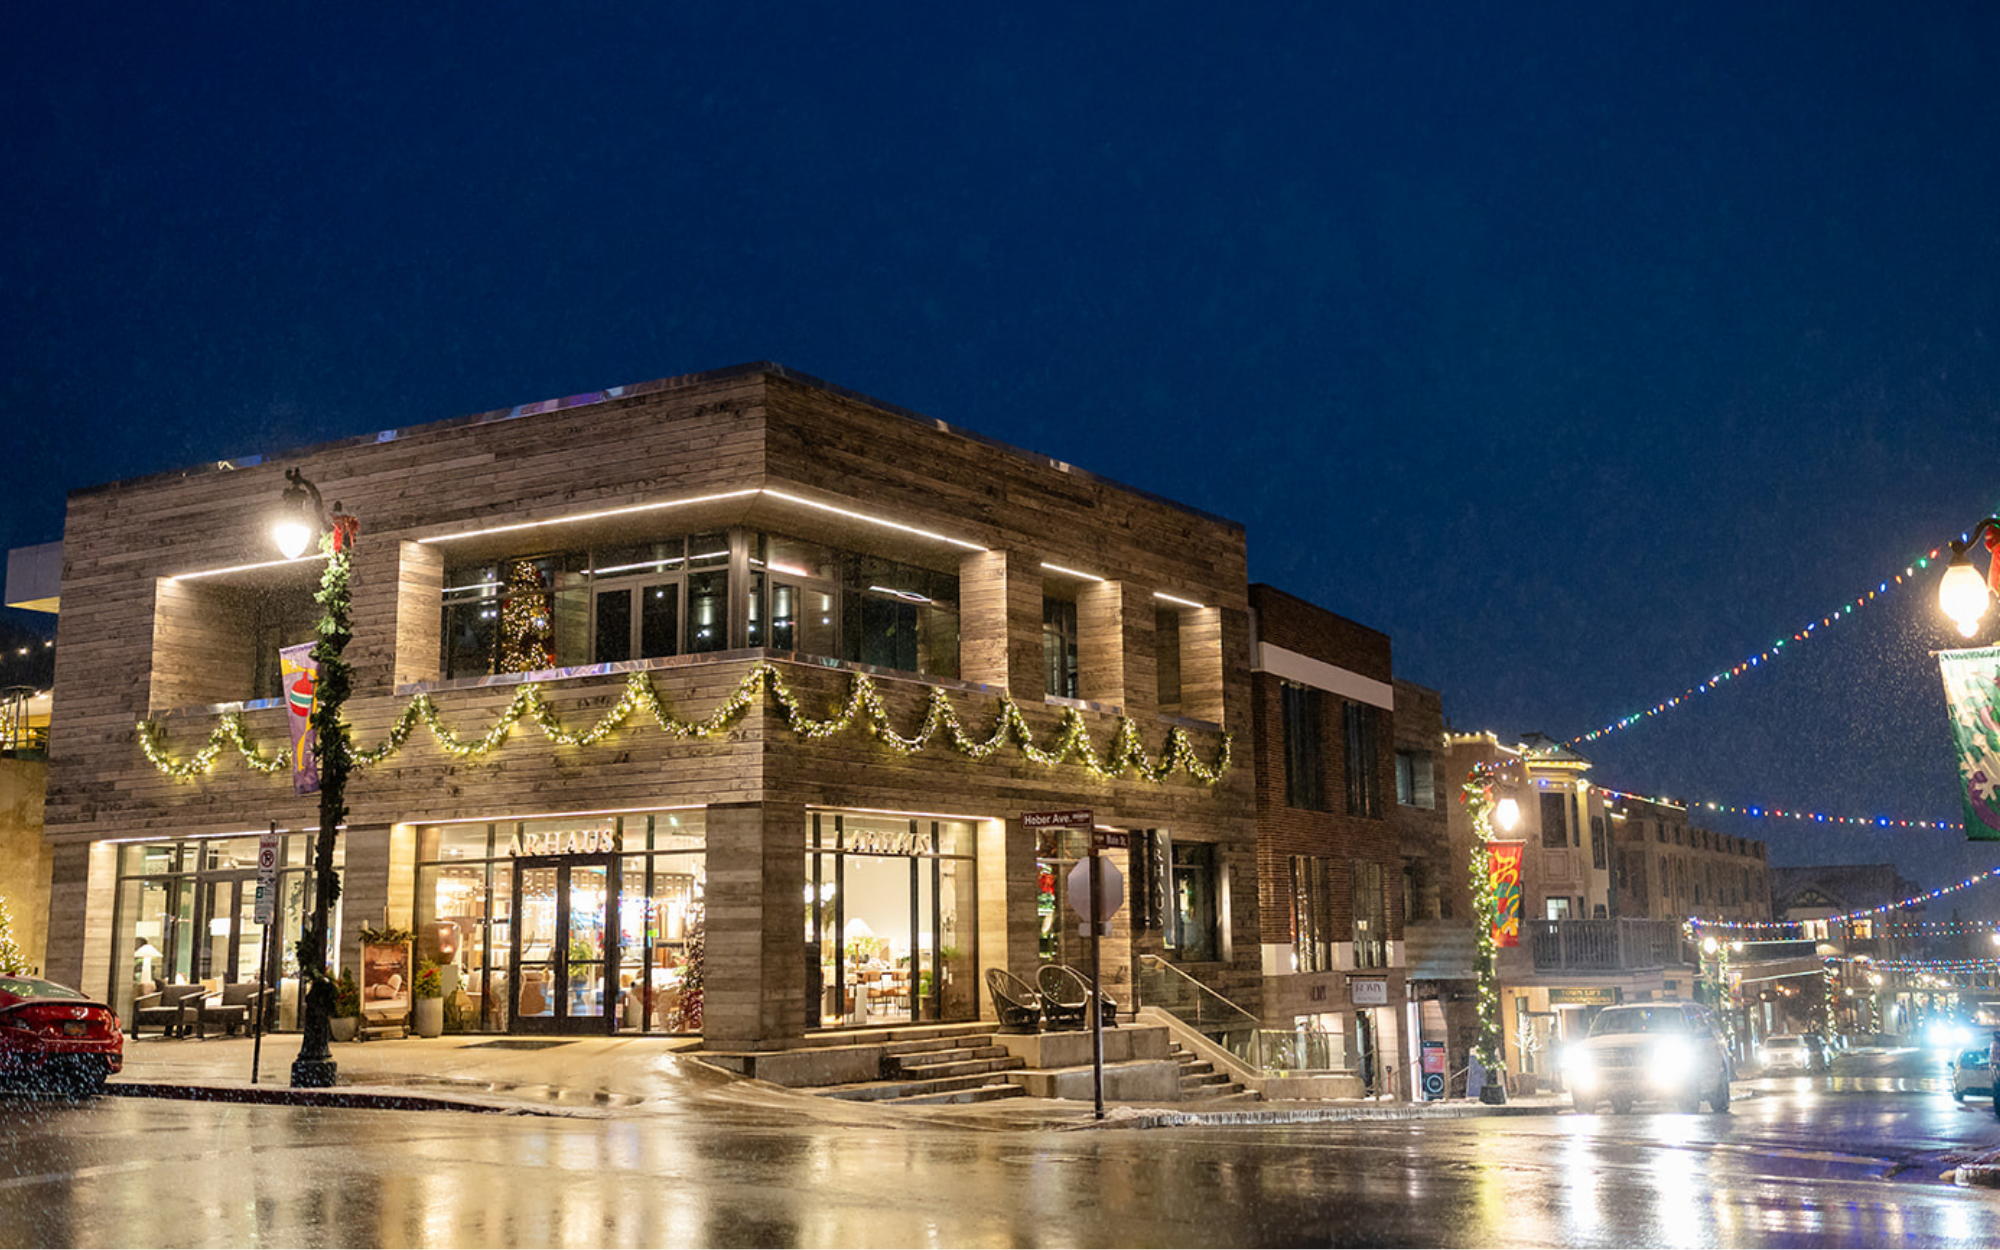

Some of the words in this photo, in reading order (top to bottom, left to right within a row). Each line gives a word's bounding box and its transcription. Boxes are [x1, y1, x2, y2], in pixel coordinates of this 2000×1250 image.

[1053, 813, 1072, 824] Ave.
[505, 829, 615, 857] ARHAUS
[1153, 832, 1165, 927] ARHAUS
